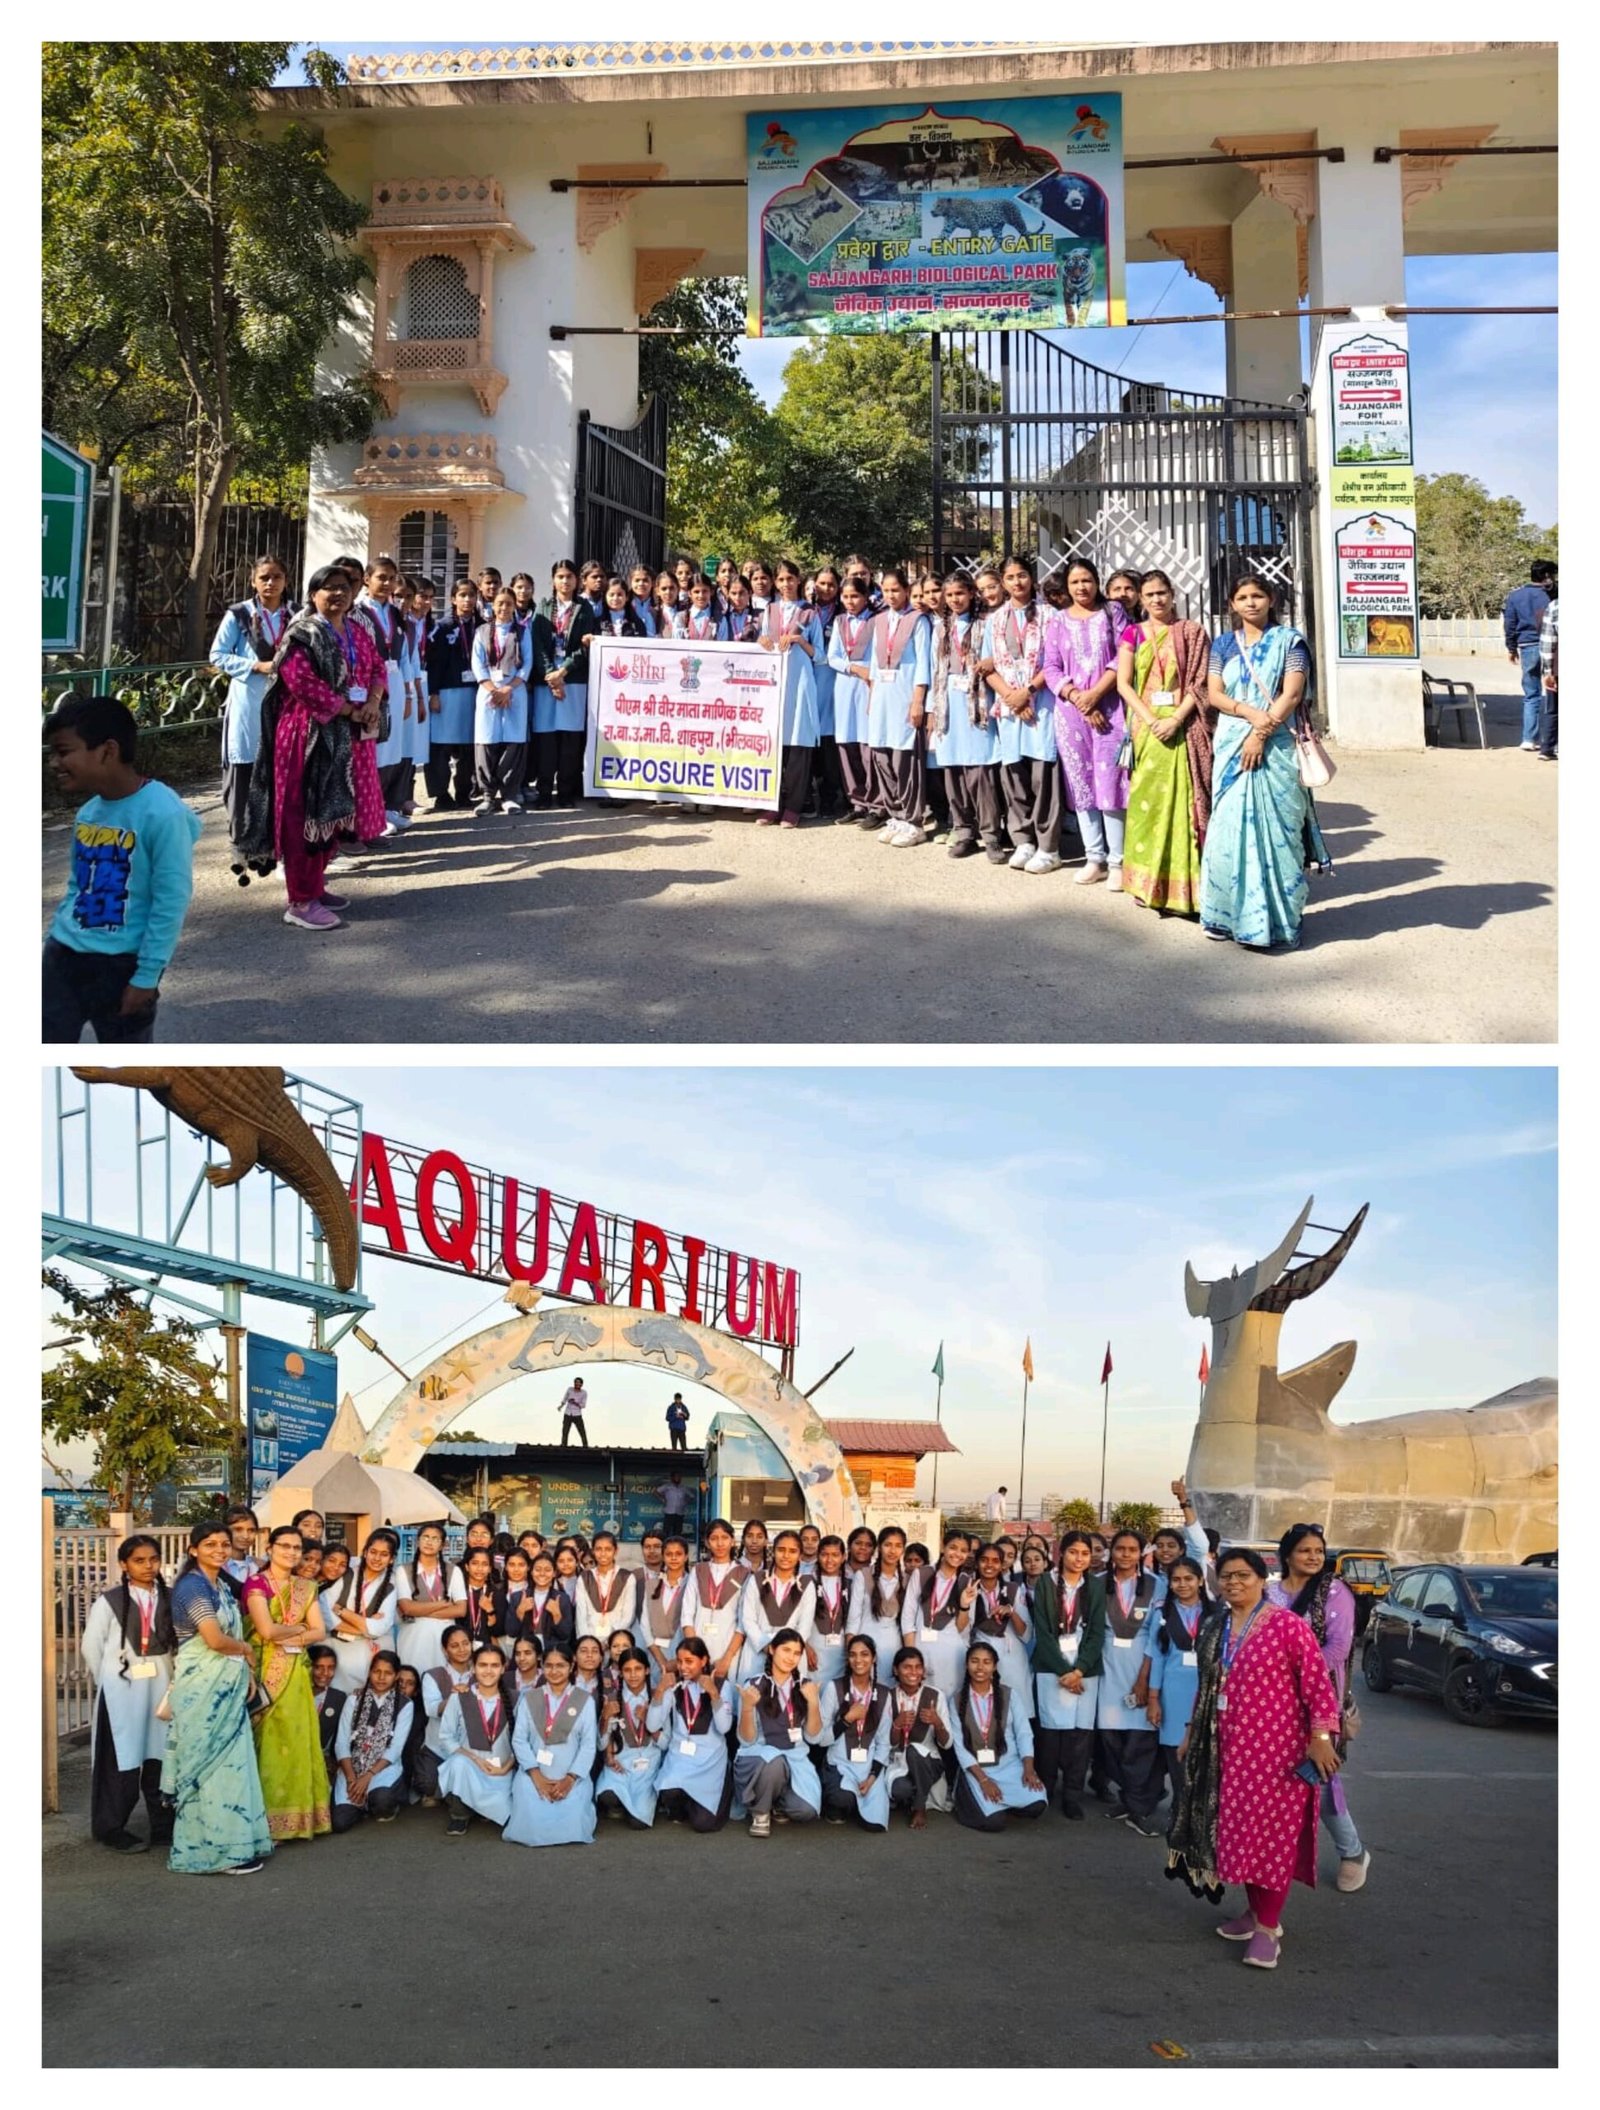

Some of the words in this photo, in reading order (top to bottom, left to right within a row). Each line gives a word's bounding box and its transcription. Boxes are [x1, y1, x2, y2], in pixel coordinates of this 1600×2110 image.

[836, 237, 876, 259] प्रवेश
[881, 239, 911, 261] द्वार
[931, 236, 997, 256] ENTRY
[1001, 234, 1055, 254] GATE
[808, 267, 913, 288] SAJJANGARH
[917, 265, 1010, 285] BIOLOGICAL
[1013, 263, 1058, 280] PARK
[834, 292, 884, 314] जैविक
[1366, 358, 1387, 366] ENTRY
[1339, 402, 1403, 411] SAJJANGARH
[1357, 412, 1384, 420] FORT
[1347, 560, 1377, 570] जैविक
[1380, 561, 1406, 570] उद्यान
[1346, 596, 1410, 604] SAJJANGARH
[1342, 604, 1390, 612] BIOLOGICAL
[1391, 604, 1413, 612] PARK
[633, 654, 652, 666] PM
[631, 665, 666, 680] SHRI
[614, 692, 641, 716] पीएम
[642, 693, 656, 717] श्री
[657, 695, 676, 720] वीर
[676, 702, 700, 720] माता
[702, 698, 737, 721] माणिक
[739, 701, 764, 724] कंवर
[677, 729, 715, 755] शाहपुरा
[600, 756, 716, 788] EXPOSURE
[721, 765, 773, 793] VISIT
[347, 1131, 798, 1347] AQUARIUM
[548, 1483, 581, 1491] UNDER
[585, 1484, 603, 1492] THE
[548, 1497, 592, 1505] DAY/NIGHT
[596, 1499, 630, 1507] TOUIST
[596, 1509, 630, 1517] UDAPUR
